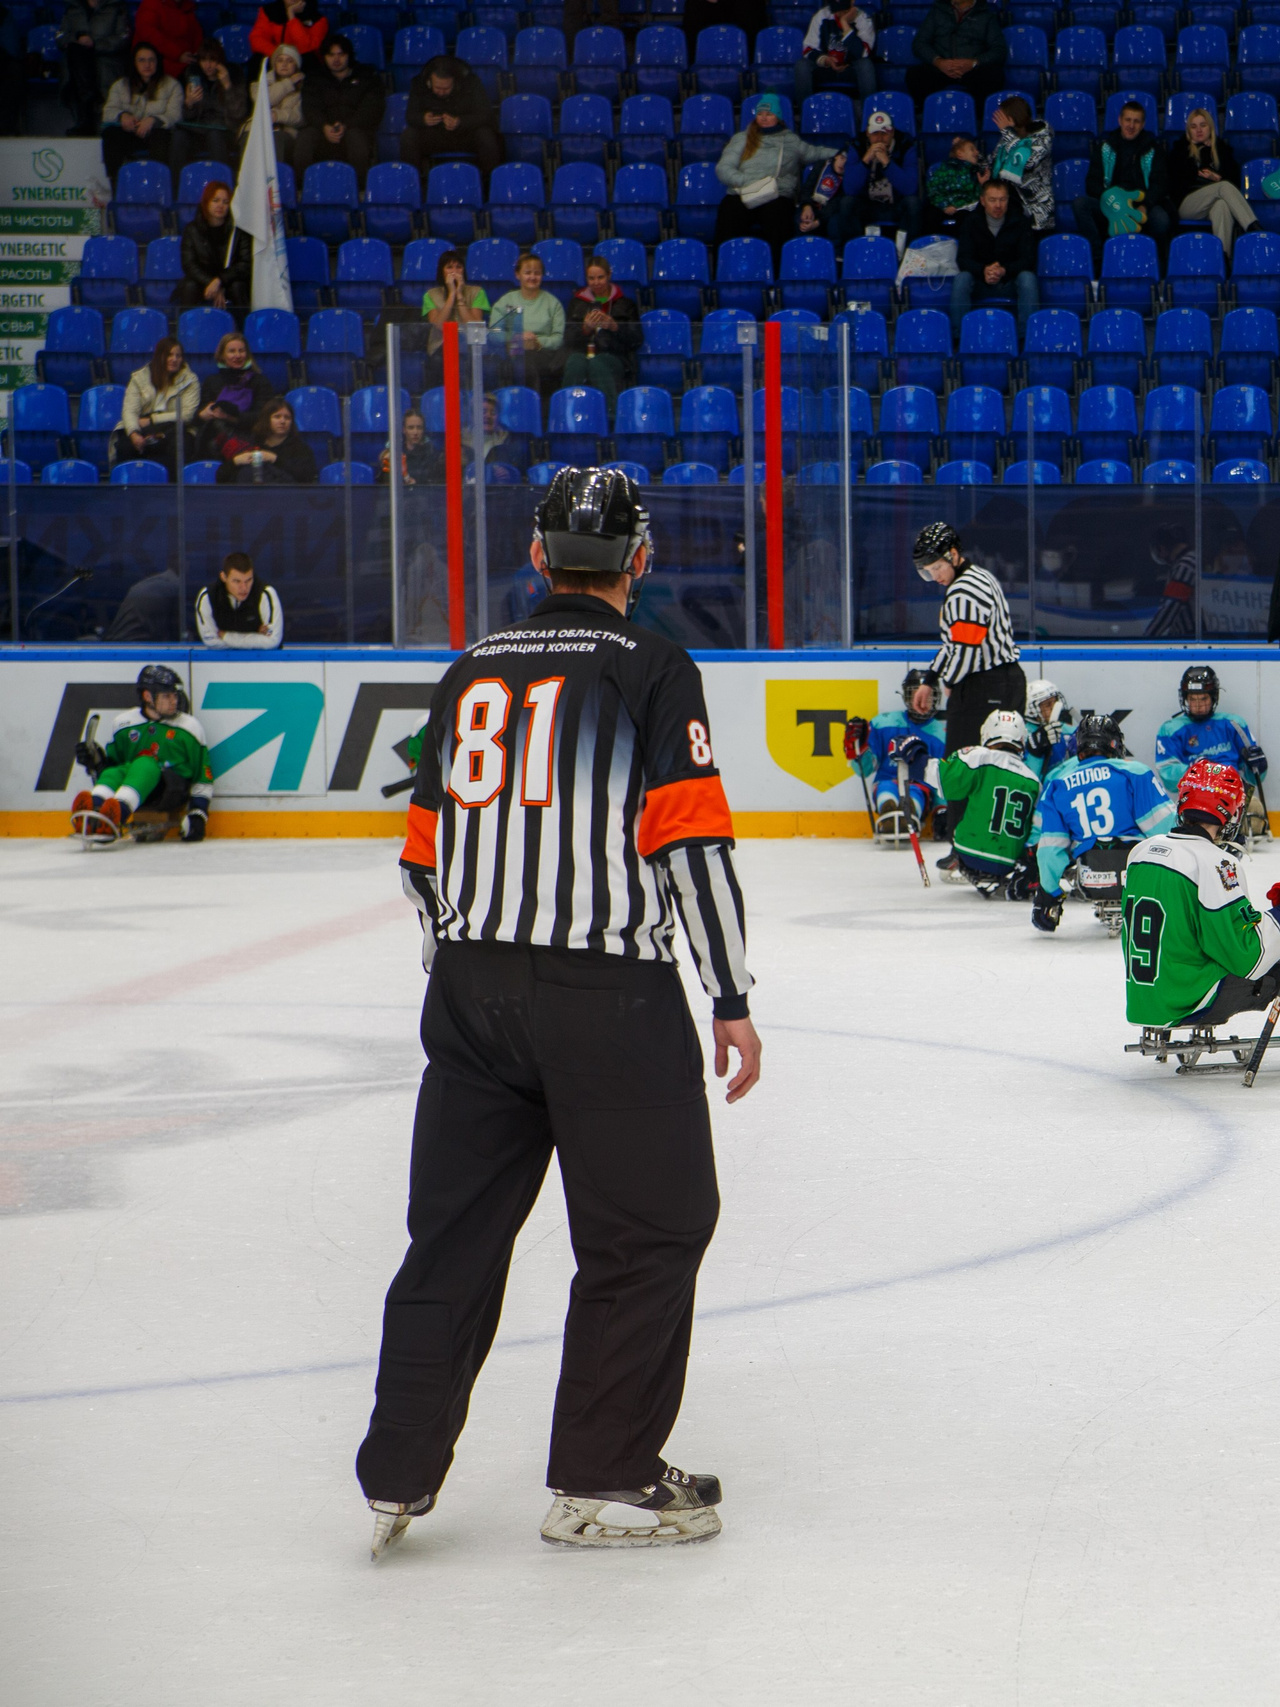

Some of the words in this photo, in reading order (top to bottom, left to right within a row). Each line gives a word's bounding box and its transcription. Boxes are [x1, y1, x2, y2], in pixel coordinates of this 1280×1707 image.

[12, 186, 88, 201] SYNERGETIC
[15, 216, 73, 227] ЧИСТОТЫ
[0, 243, 67, 257] YNERGETIC
[0, 269, 52, 281] РАСОТЫ
[0, 294, 45, 307] RGETIC
[558, 629, 637, 650] ОБЛАСТНАЯ
[472, 643, 545, 658] ФЕДЕРАЦИЯ
[546, 643, 597, 653] ХОККЕЯ
[447, 676, 566, 810] 81
[1063, 766, 1111, 791] ТЕПЛОВ
[989, 786, 1033, 840] 13
[1070, 787, 1115, 839] 13
[1123, 895, 1167, 986] 19
